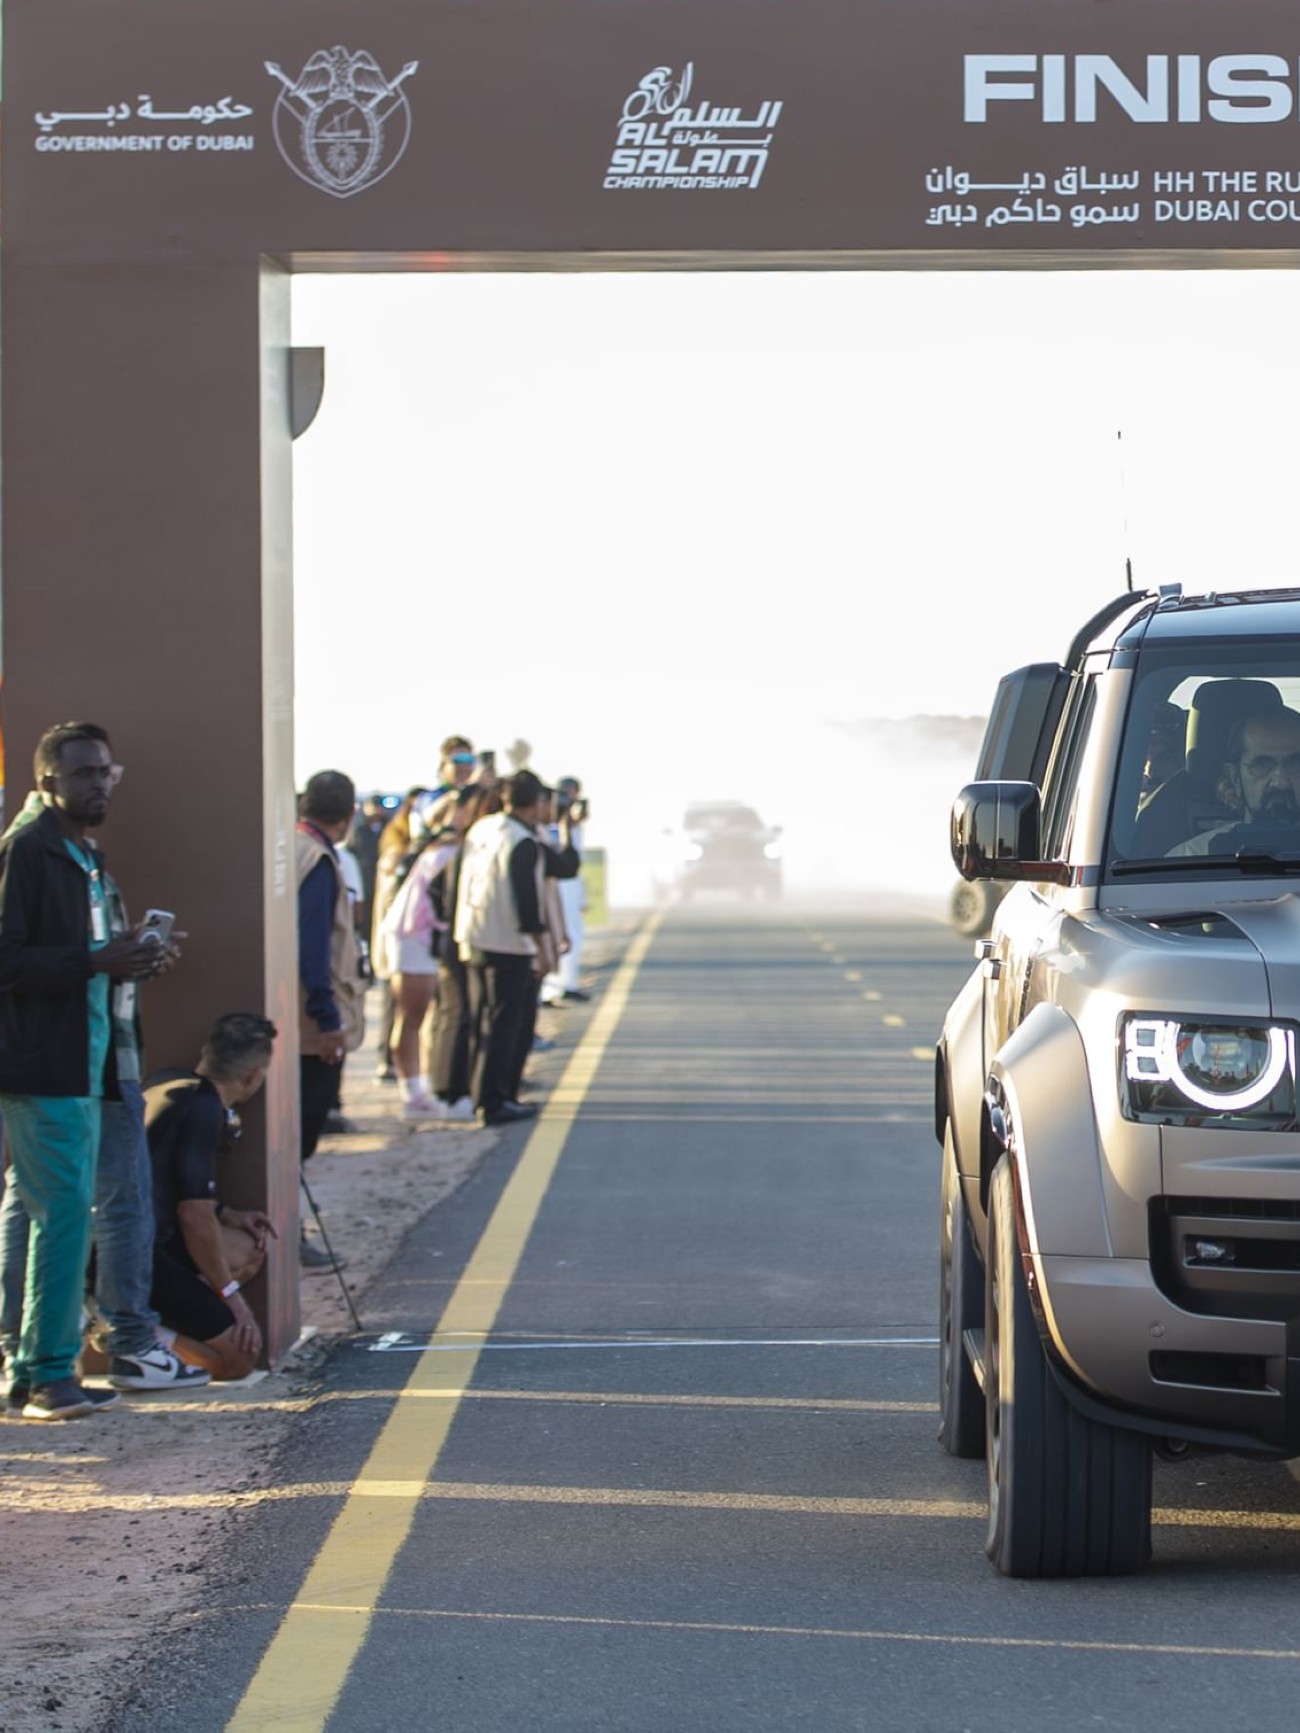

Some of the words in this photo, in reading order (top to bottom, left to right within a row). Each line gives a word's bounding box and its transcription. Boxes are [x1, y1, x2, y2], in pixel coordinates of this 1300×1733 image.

[34, 102, 131, 132] دبي
[137, 94, 253, 125] حكومة
[35, 135, 165, 151] GOVERNMENT
[167, 135, 193, 151] OF
[196, 135, 254, 150] DUBAI
[616, 122, 667, 146] AL
[606, 148, 769, 188] SALAM
[925, 165, 1046, 195] ديوان
[1053, 165, 1140, 195] سباق
[602, 175, 750, 189] CHAMPIONSHIP
[1153, 171, 1195, 193] HH
[1202, 171, 1257, 193] THE
[925, 204, 978, 228] دبي
[984, 198, 1062, 228] حاكم
[1069, 203, 1140, 228] سمو
[1154, 200, 1240, 221] DUBAI
